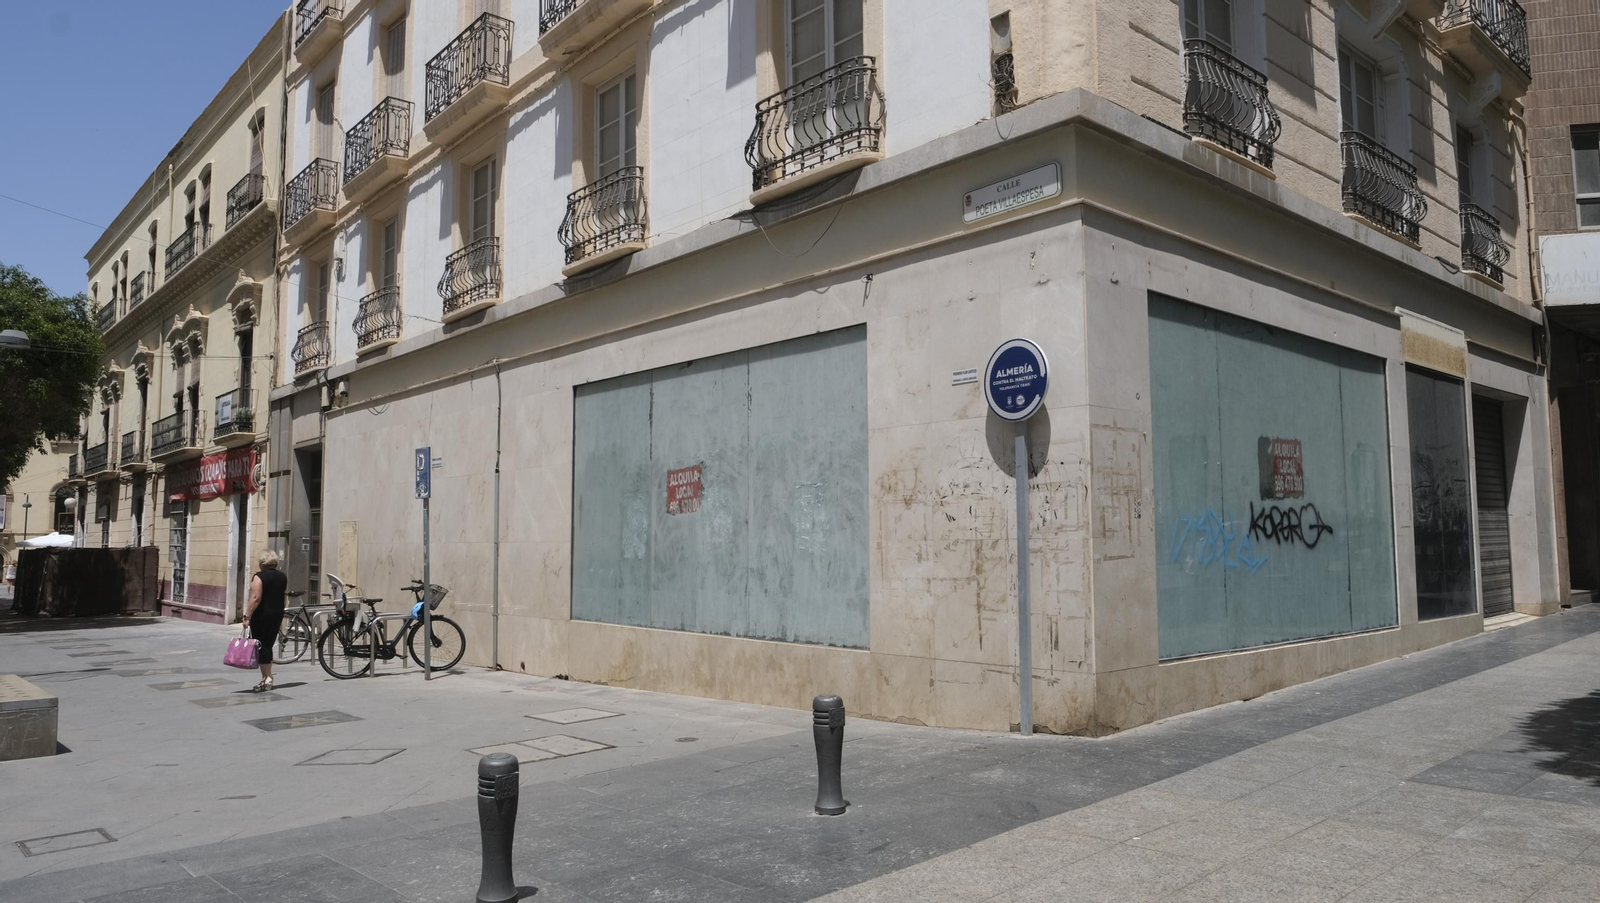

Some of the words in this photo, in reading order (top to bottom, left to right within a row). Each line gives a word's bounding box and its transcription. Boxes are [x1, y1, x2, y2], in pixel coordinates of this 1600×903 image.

[996, 179, 1021, 193] CALLE
[975, 201, 997, 218] POETA
[998, 185, 1044, 208] VILLAESPESA
[996, 363, 1034, 378] ALMERÍA
[1015, 374, 1038, 382] MALTRATO
[1274, 443, 1300, 458] ALQUILA
[670, 470, 699, 486] ALQUILA
